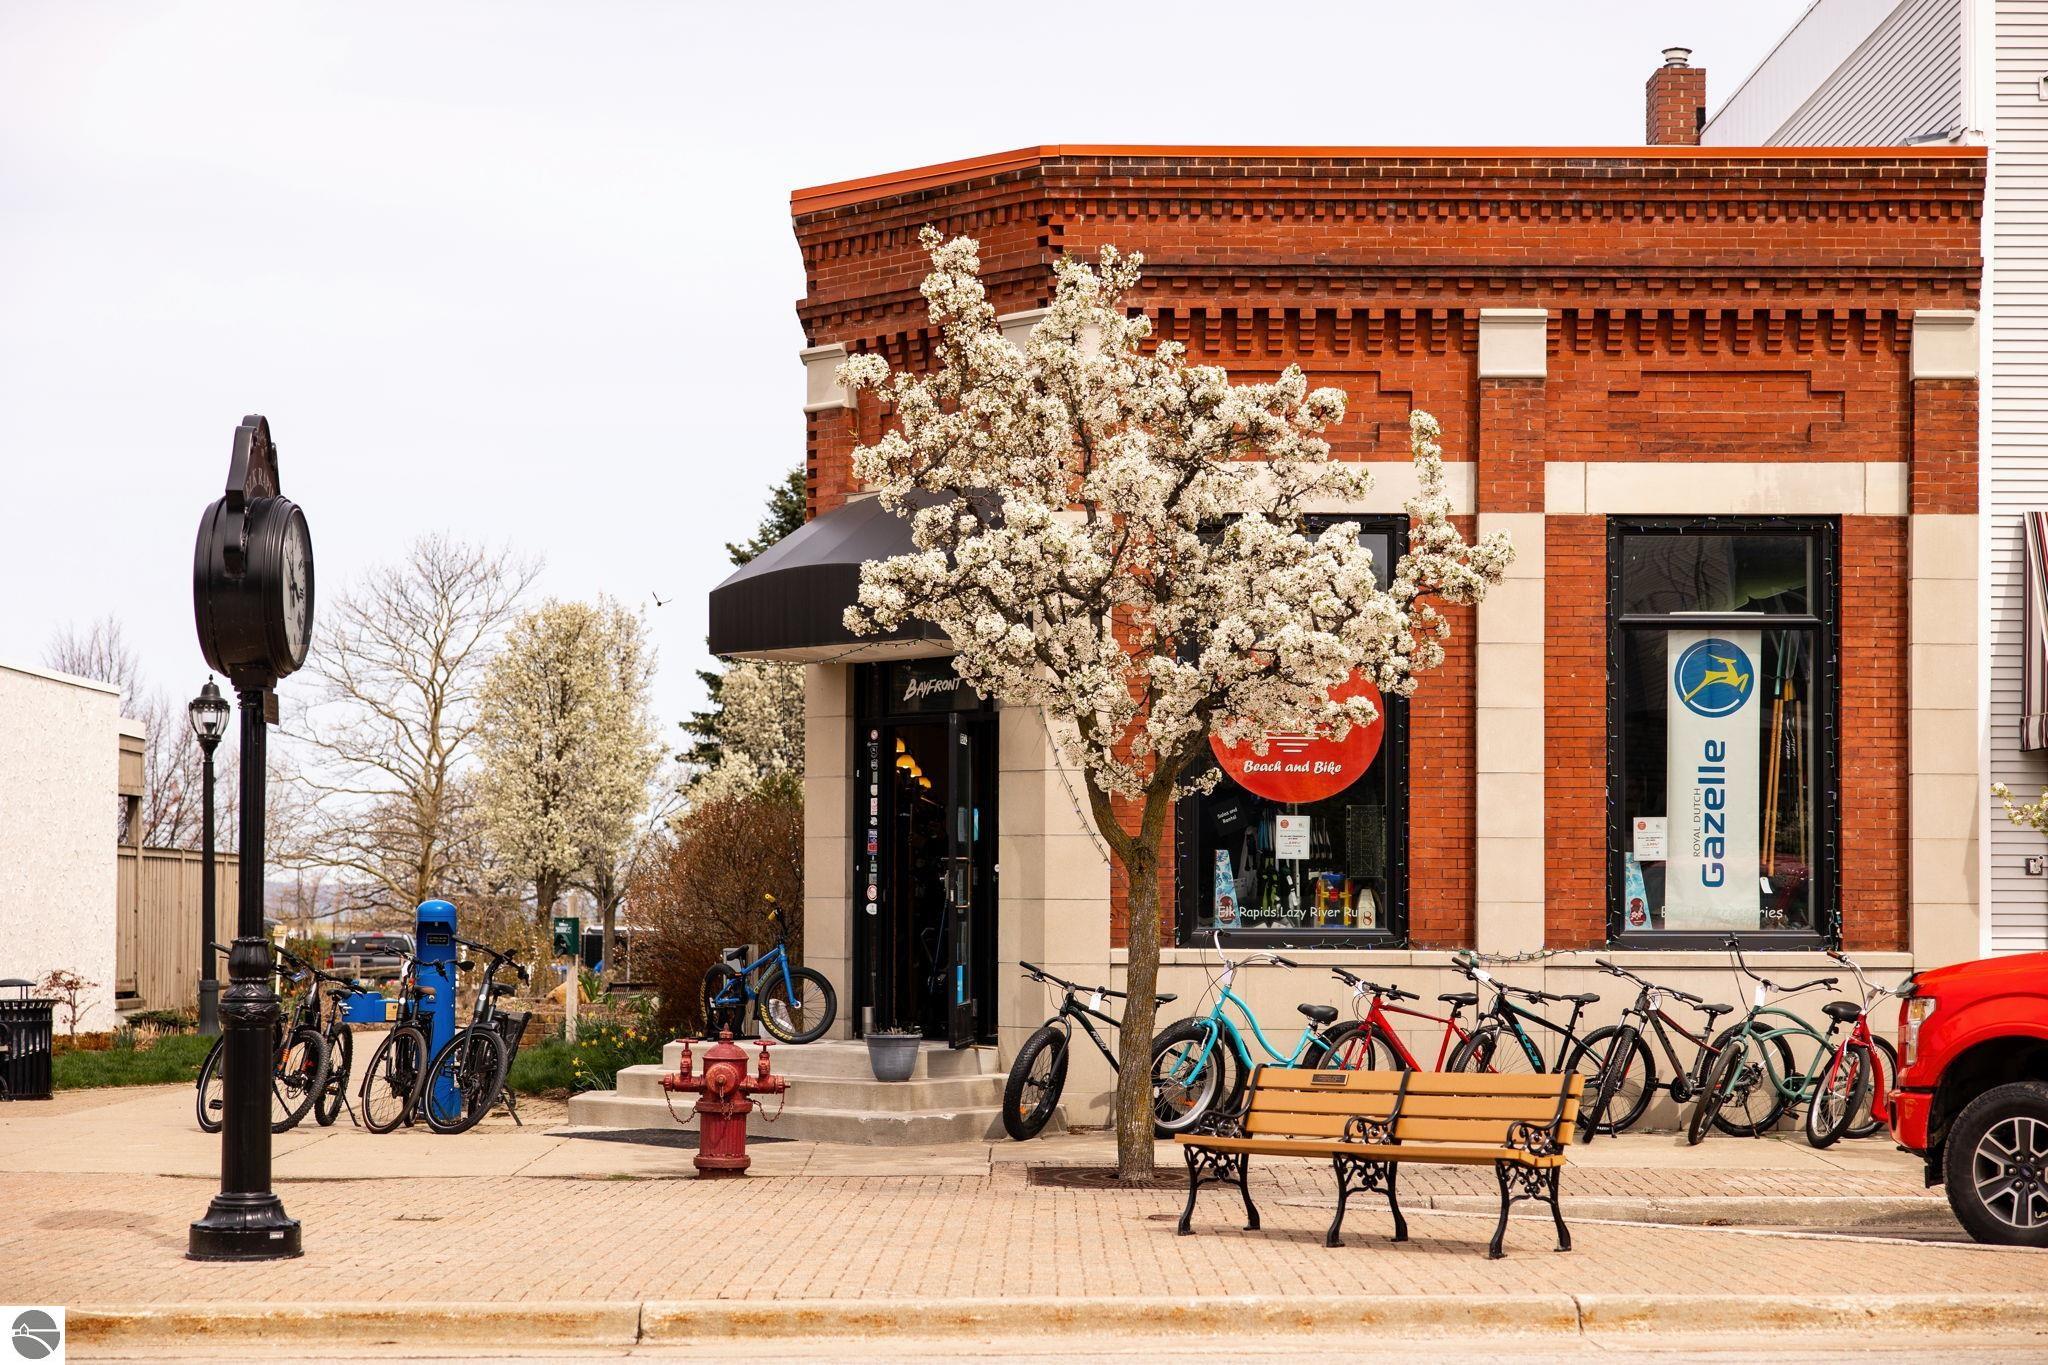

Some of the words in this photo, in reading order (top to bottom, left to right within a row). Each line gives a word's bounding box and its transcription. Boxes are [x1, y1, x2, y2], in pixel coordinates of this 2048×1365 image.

[903, 677, 962, 701] BAYFRONT
[1243, 760, 1281, 773] Beach
[1285, 760, 1310, 772] and
[1313, 761, 1342, 775] Bike
[1697, 739, 1726, 888] Gazelle
[1218, 906, 1236, 918] Elk
[1240, 906, 1276, 921] Rapids
[1280, 906, 1307, 920] Lazy
[1310, 907, 1340, 918] River
[1344, 906, 1358, 917] Ru
